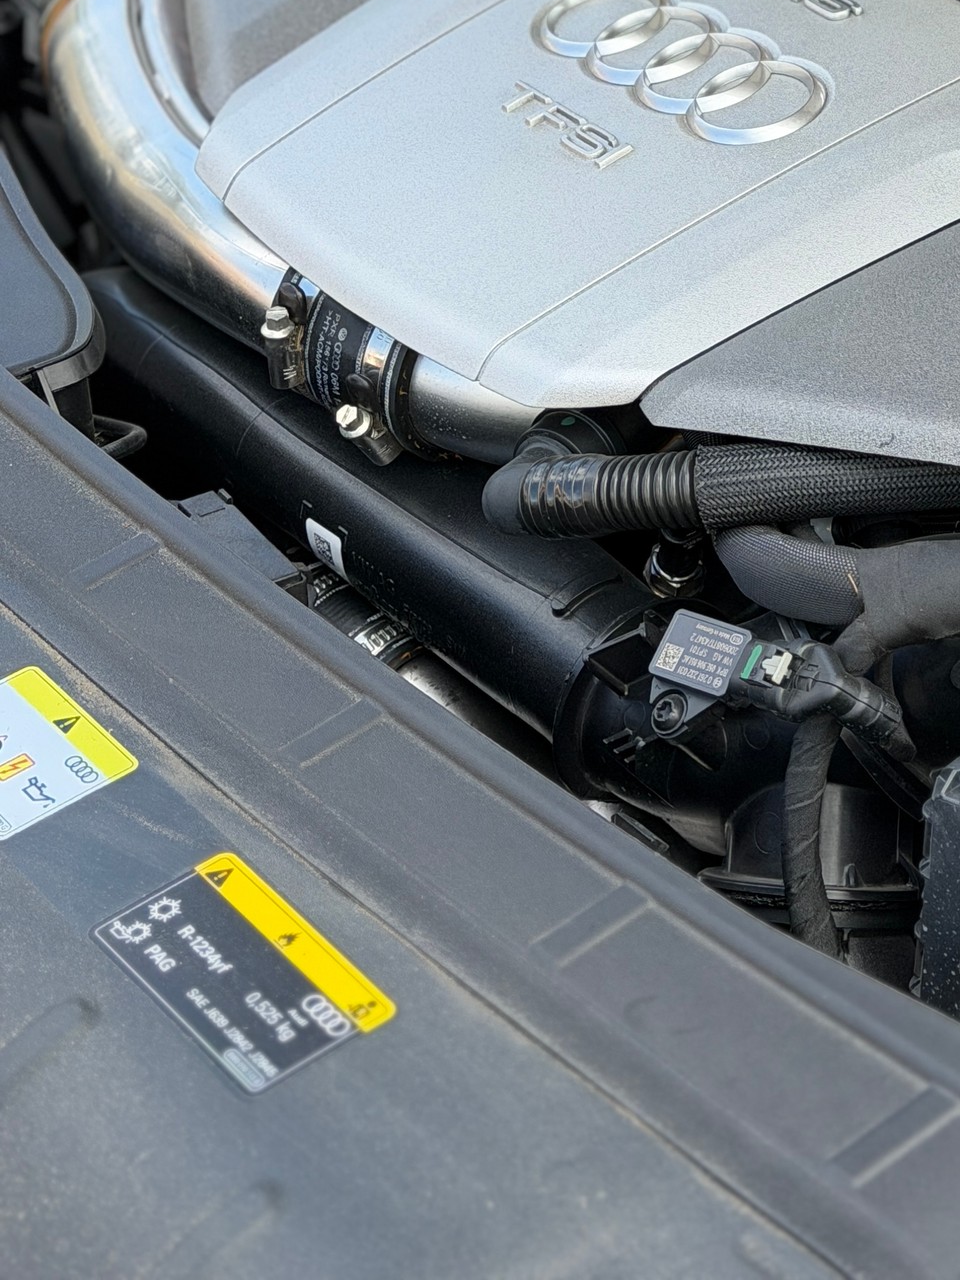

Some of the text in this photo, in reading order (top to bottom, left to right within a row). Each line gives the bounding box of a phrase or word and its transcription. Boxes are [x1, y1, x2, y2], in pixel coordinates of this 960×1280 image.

[501, 79, 636, 171] TFSI
[328, 313, 340, 337] PXR
[696, 623, 714, 633] Germany
[718, 631, 730, 639] Made
[712, 653, 723, 661] AG
[723, 656, 733, 665] VW
[176, 924, 234, 975] R-1234yf
[244, 991, 284, 1026] 0,525
[275, 1021, 297, 1043] kg
[144, 944, 177, 973] PAG
[185, 987, 211, 1008] SAE
[204, 1004, 229, 1032] J639
[223, 1024, 254, 1052] J2842
[287, 1008, 309, 1027] Audi
